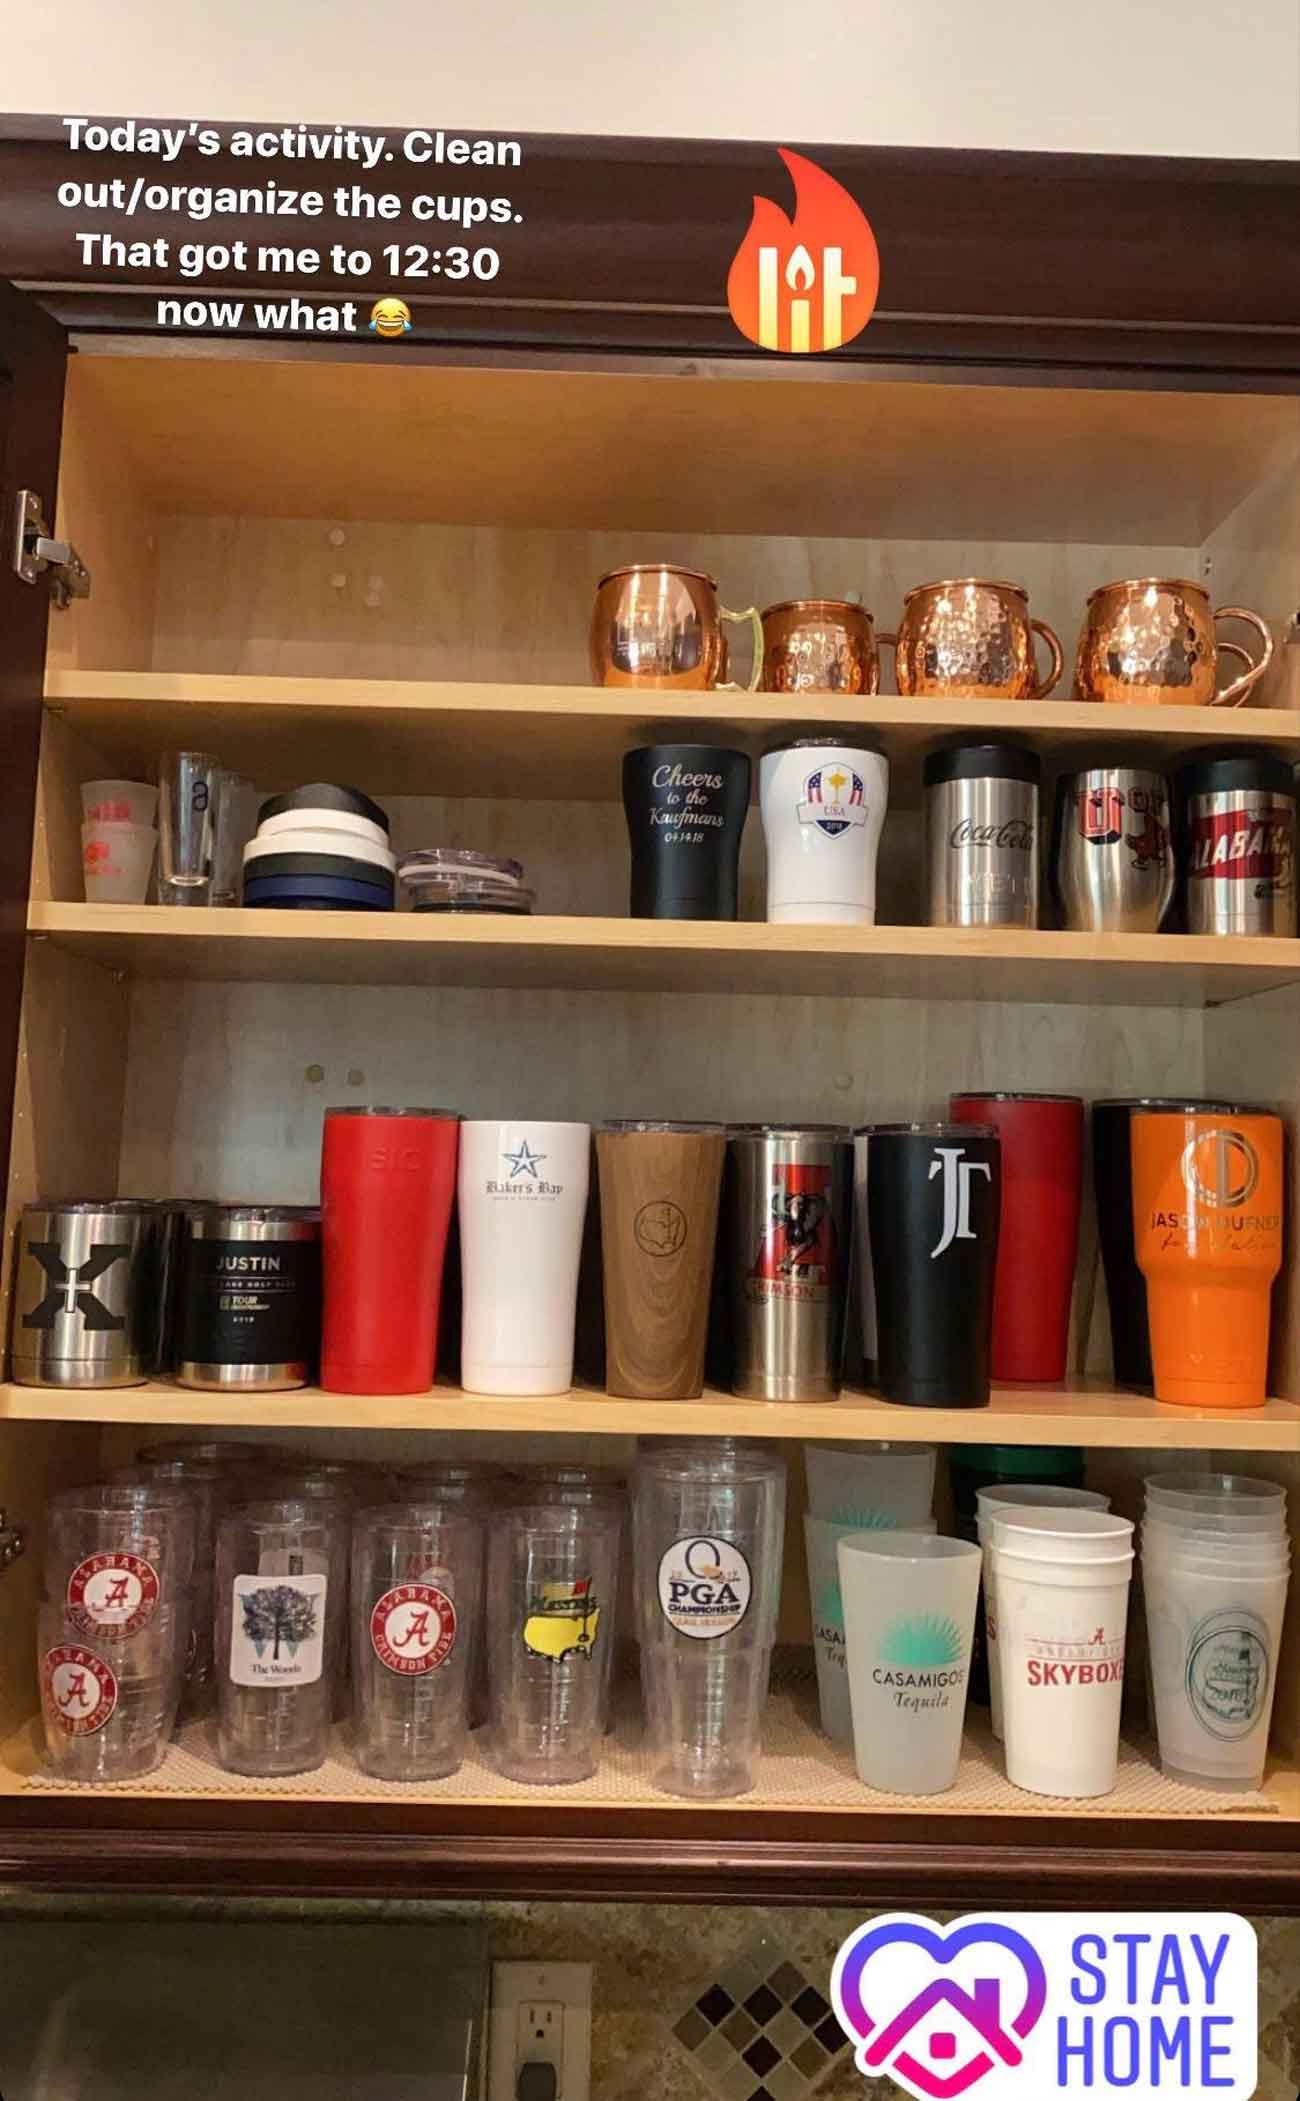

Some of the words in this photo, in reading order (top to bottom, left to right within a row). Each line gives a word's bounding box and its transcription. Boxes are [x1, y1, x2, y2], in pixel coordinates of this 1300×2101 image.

[652, 763, 723, 789] Cheers
[667, 791, 680, 805] to
[686, 788, 708, 805] the
[649, 806, 724, 829] Kaufmans
[216, 1256, 280, 1271] JUSTIN
[374, 1587, 452, 1621] ALABAMA
[669, 1582, 740, 1605] PGA
[894, 1690, 950, 1713] Tequila
